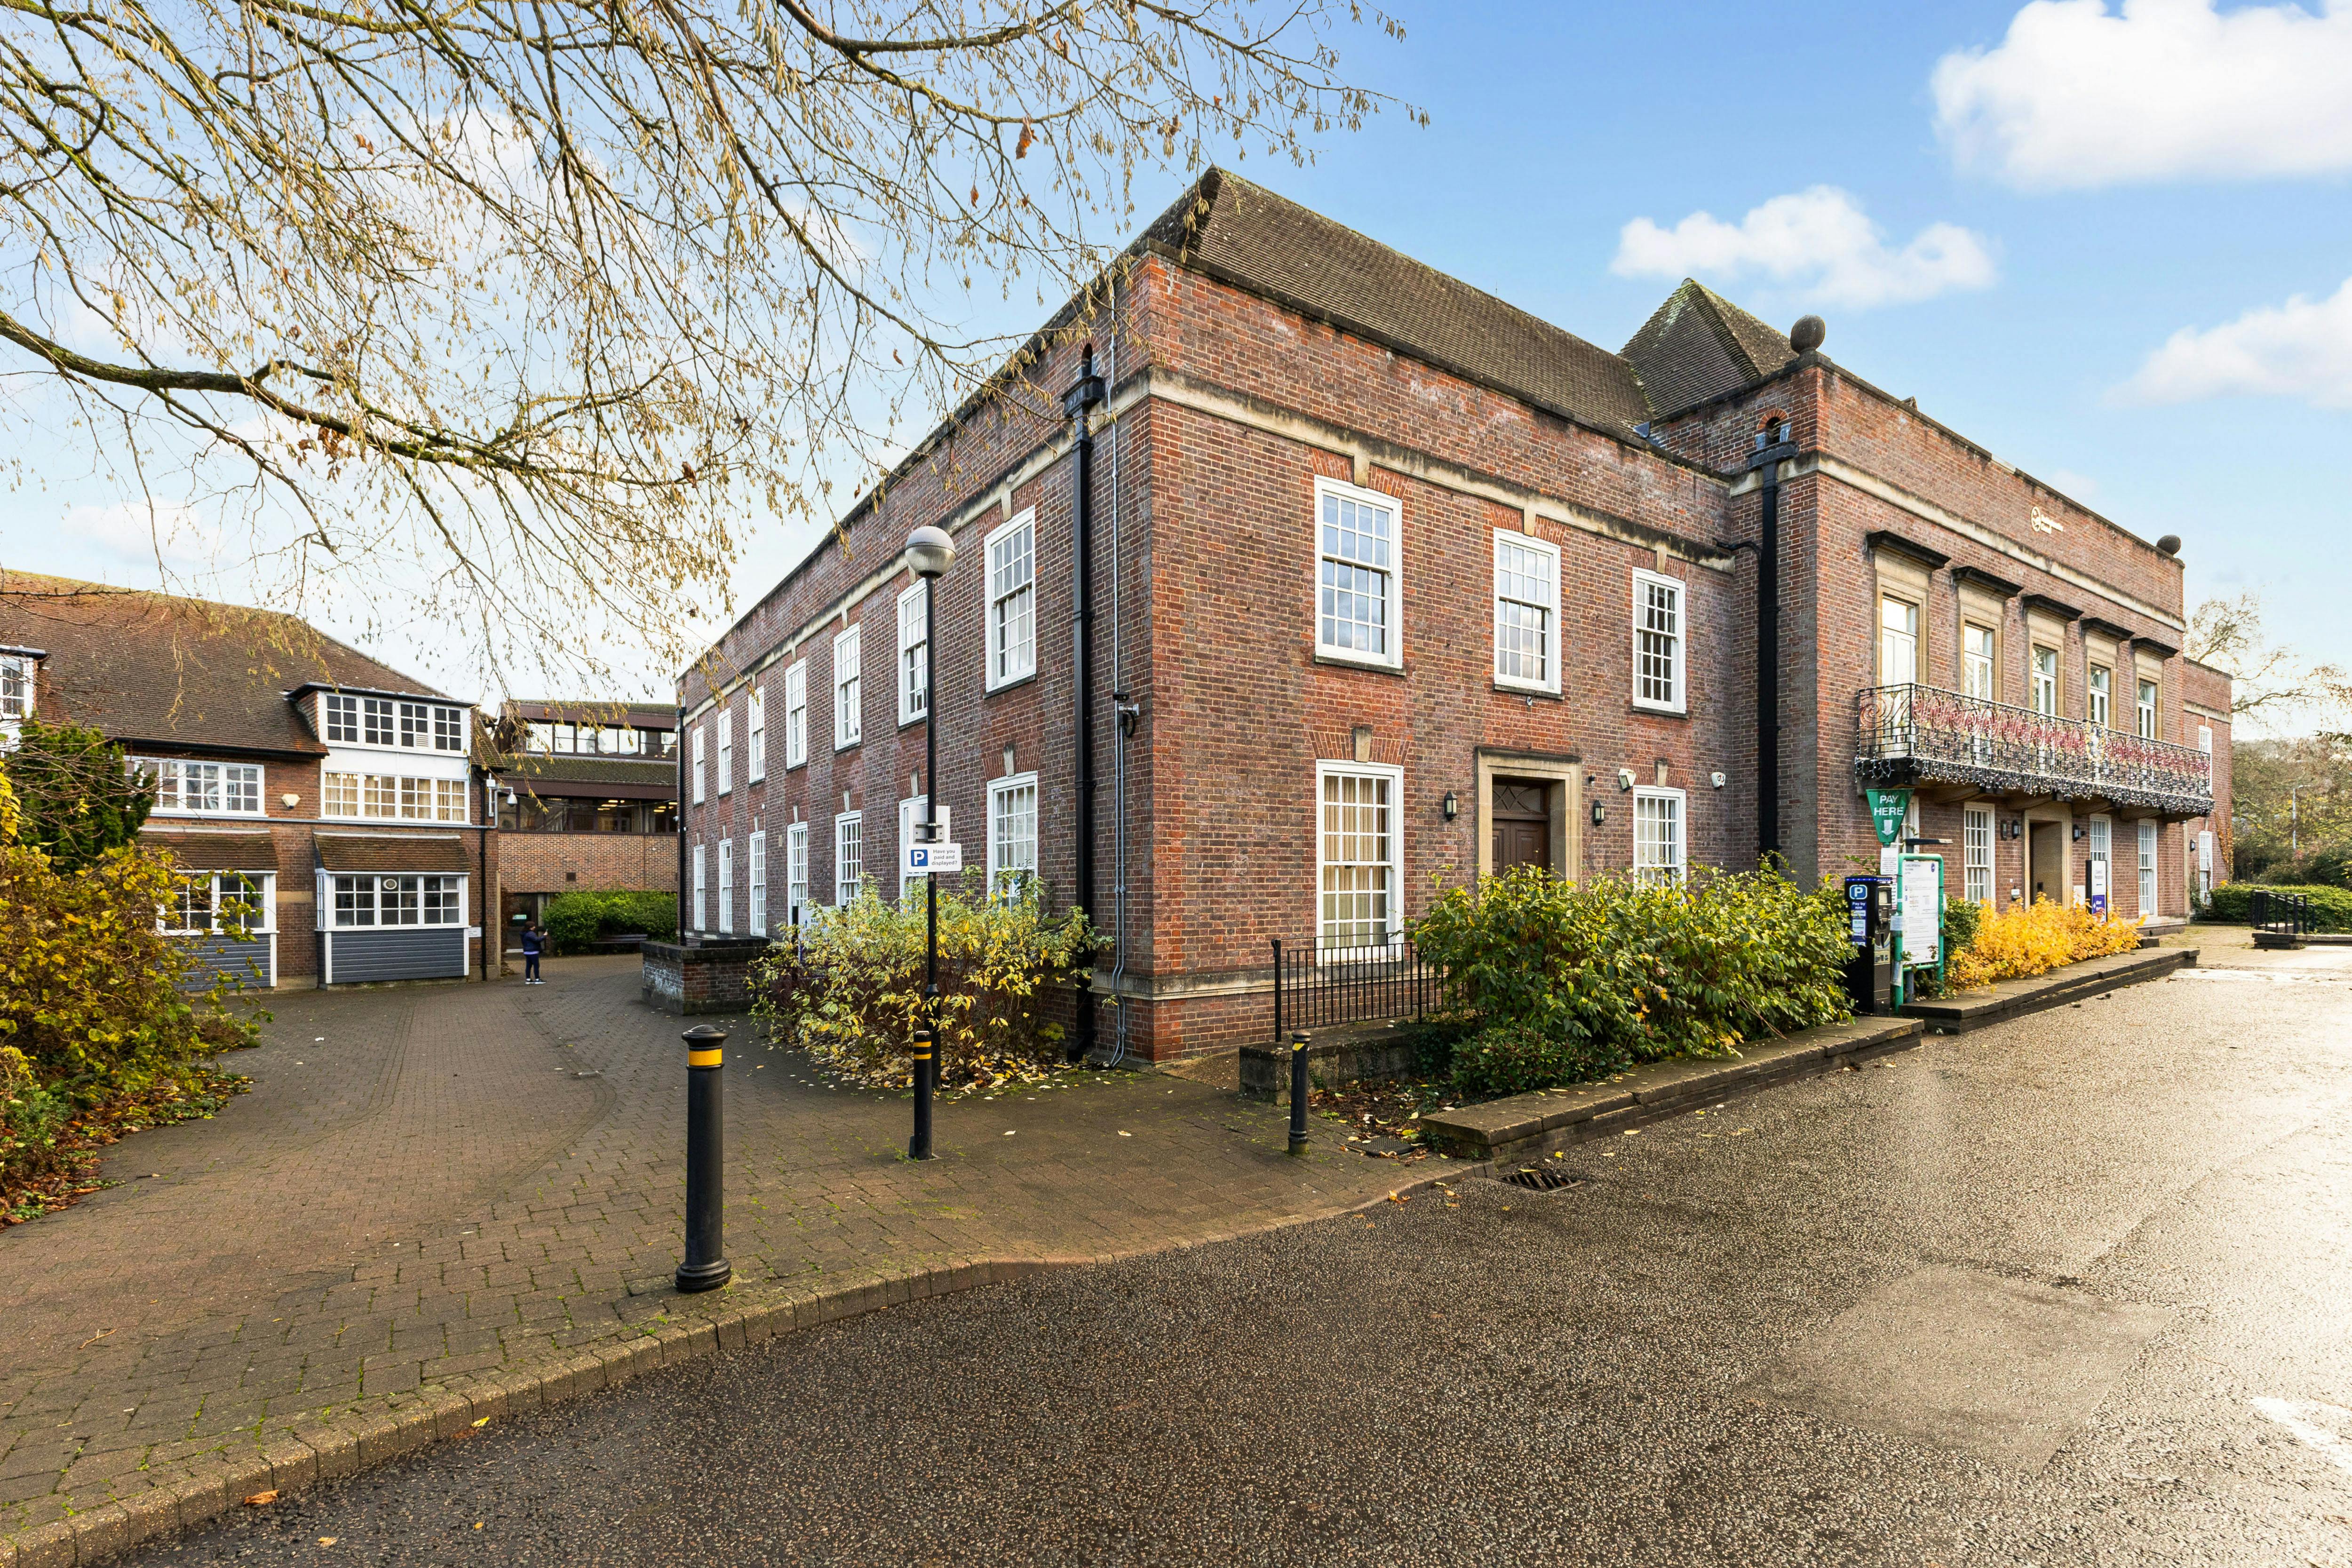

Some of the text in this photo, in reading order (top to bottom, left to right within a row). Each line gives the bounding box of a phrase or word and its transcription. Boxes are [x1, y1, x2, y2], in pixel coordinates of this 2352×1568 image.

[1880, 795, 1899, 804] PAY
[1874, 807, 1904, 816] HERE
[914, 851, 924, 865] P
[1854, 887, 1863, 897] P
